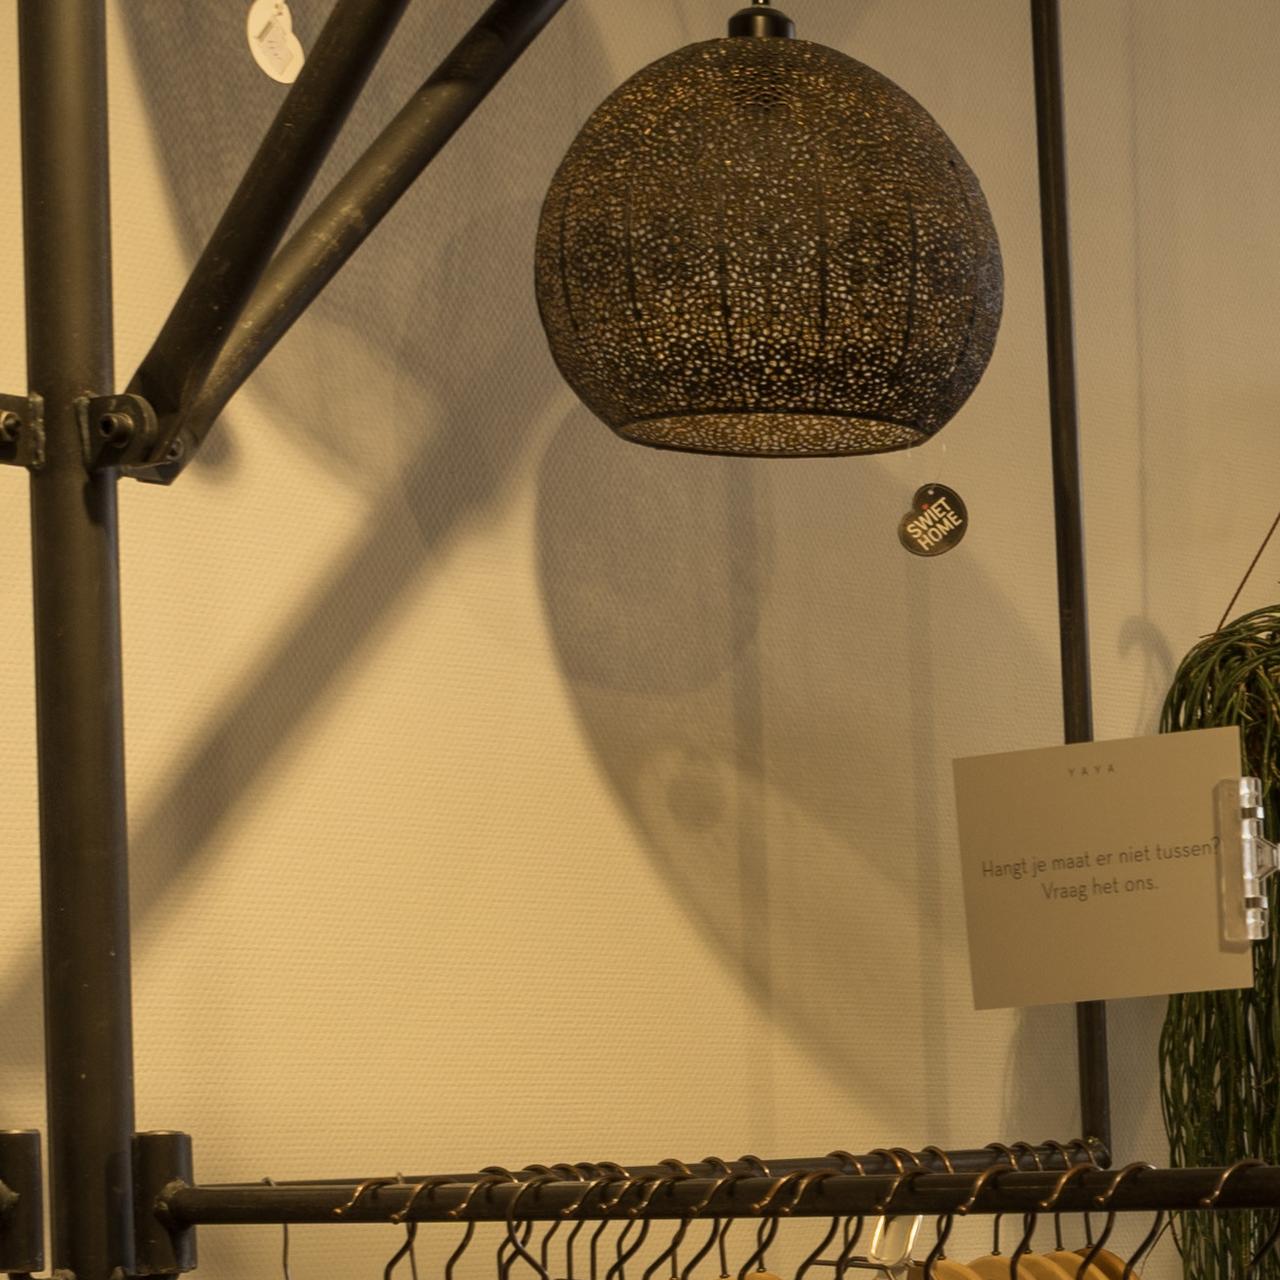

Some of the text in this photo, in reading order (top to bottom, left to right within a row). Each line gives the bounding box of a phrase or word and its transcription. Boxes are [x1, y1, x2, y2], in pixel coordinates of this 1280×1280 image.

[906, 496, 952, 539] SWIET
[917, 510, 963, 551] HOME
[1067, 763, 1116, 778] YAYA
[981, 835, 1220, 880] Hangt je maat er niet tussen?
[1041, 875, 1160, 902] Vraag het ons.
